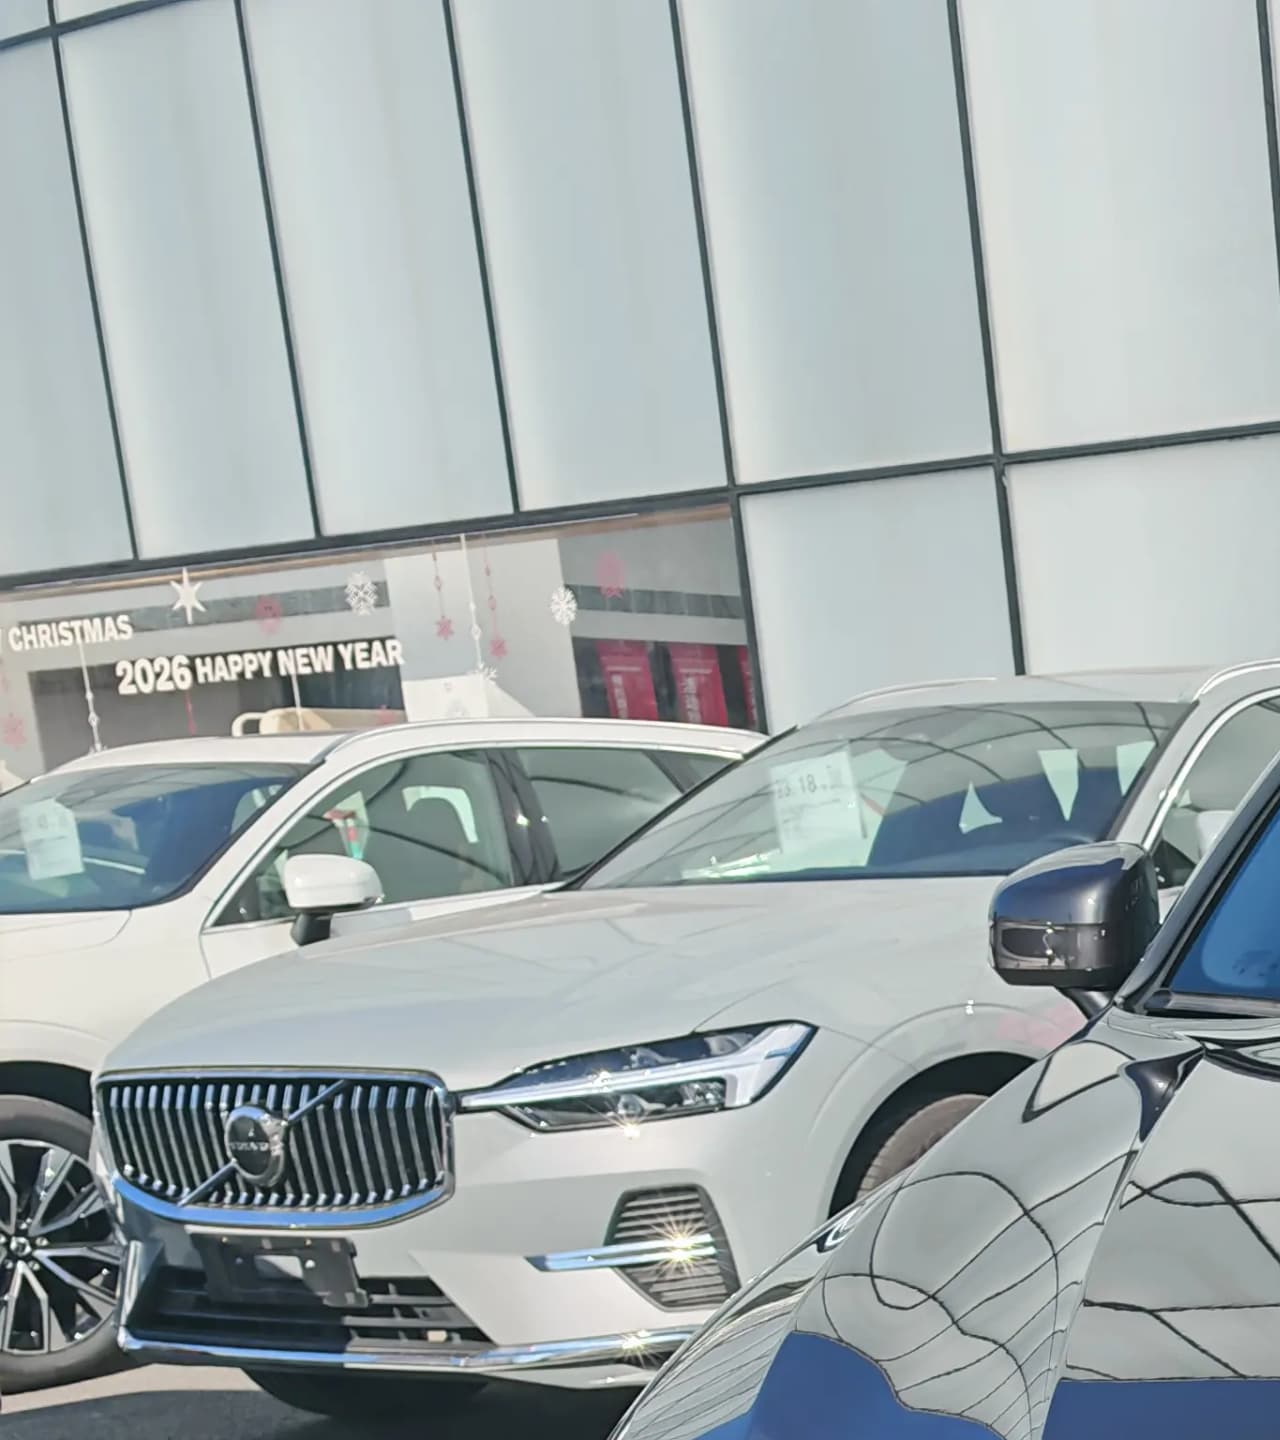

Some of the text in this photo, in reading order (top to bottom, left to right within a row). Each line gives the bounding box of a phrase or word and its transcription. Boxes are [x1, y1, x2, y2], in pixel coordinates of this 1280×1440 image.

[8, 614, 133, 651] CHRISTMAS
[115, 639, 406, 695] 2026 HAPPY NEW YEAR
